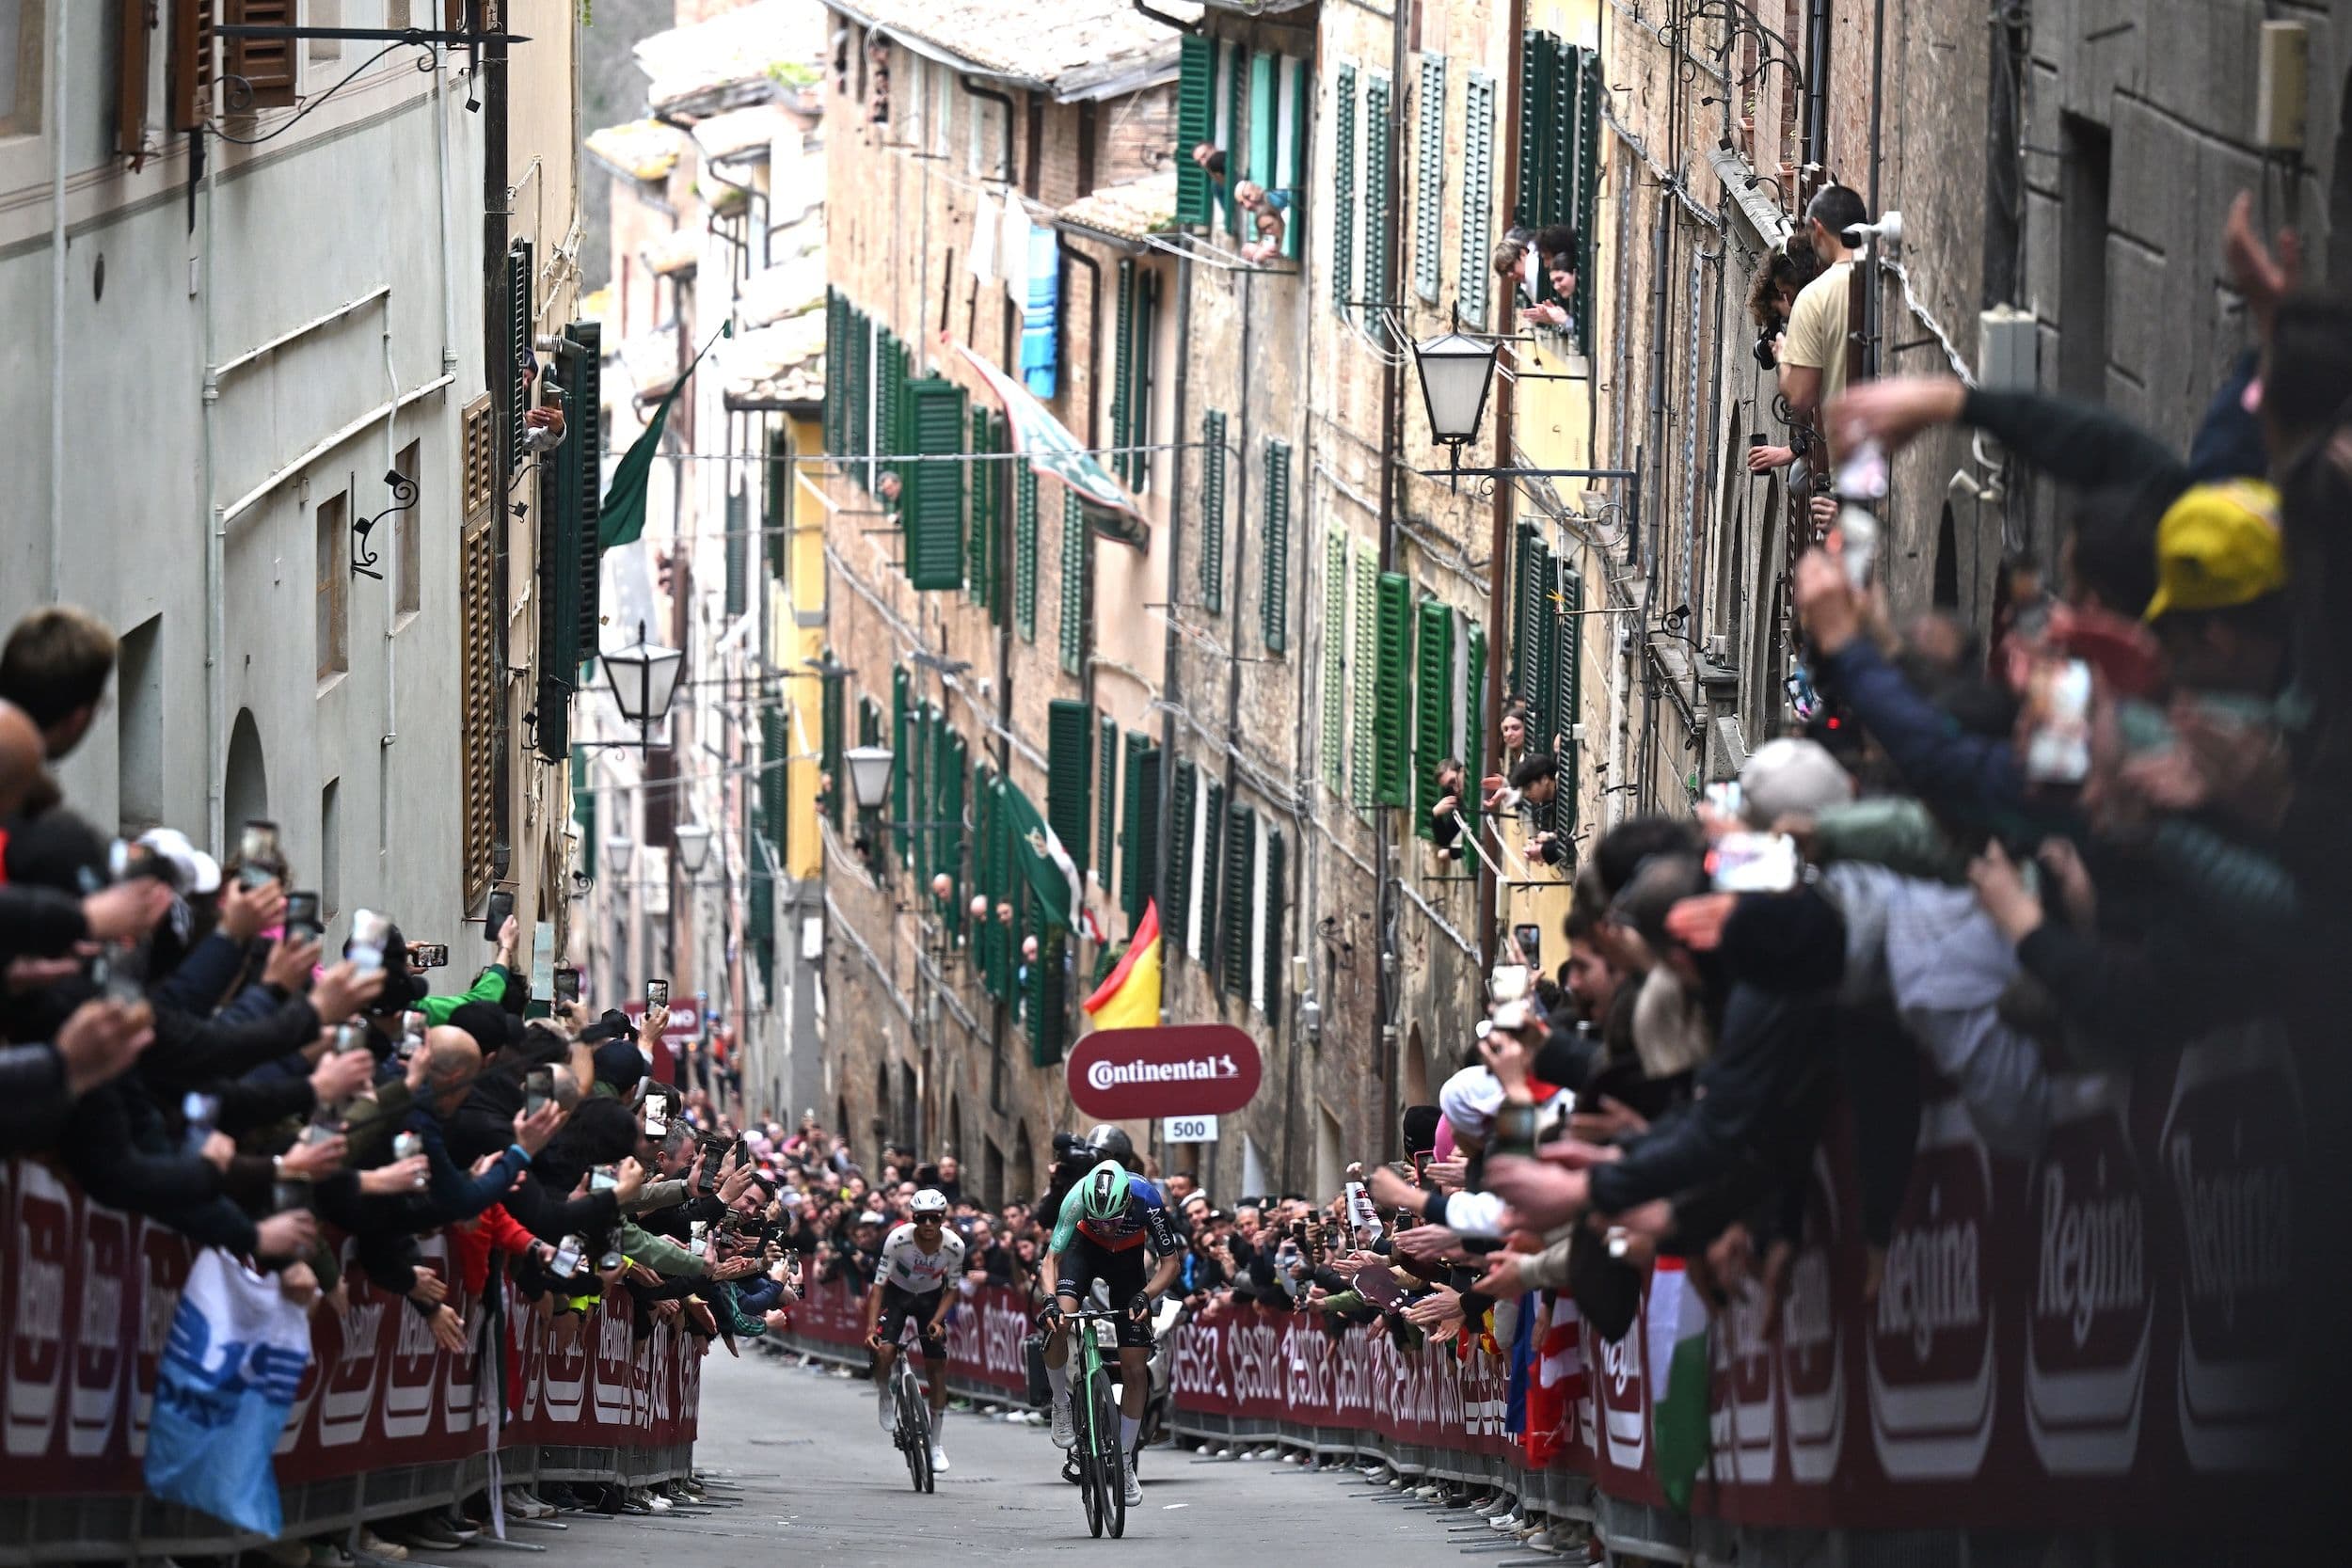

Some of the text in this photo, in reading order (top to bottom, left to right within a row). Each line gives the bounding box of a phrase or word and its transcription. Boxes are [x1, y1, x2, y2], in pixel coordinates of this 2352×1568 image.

[1088, 1056, 1216, 1090] Continental
[1173, 1121, 1205, 1137] 500
[1147, 1207, 1170, 1246] Adecco
[2038, 1153, 2144, 1348] Regina
